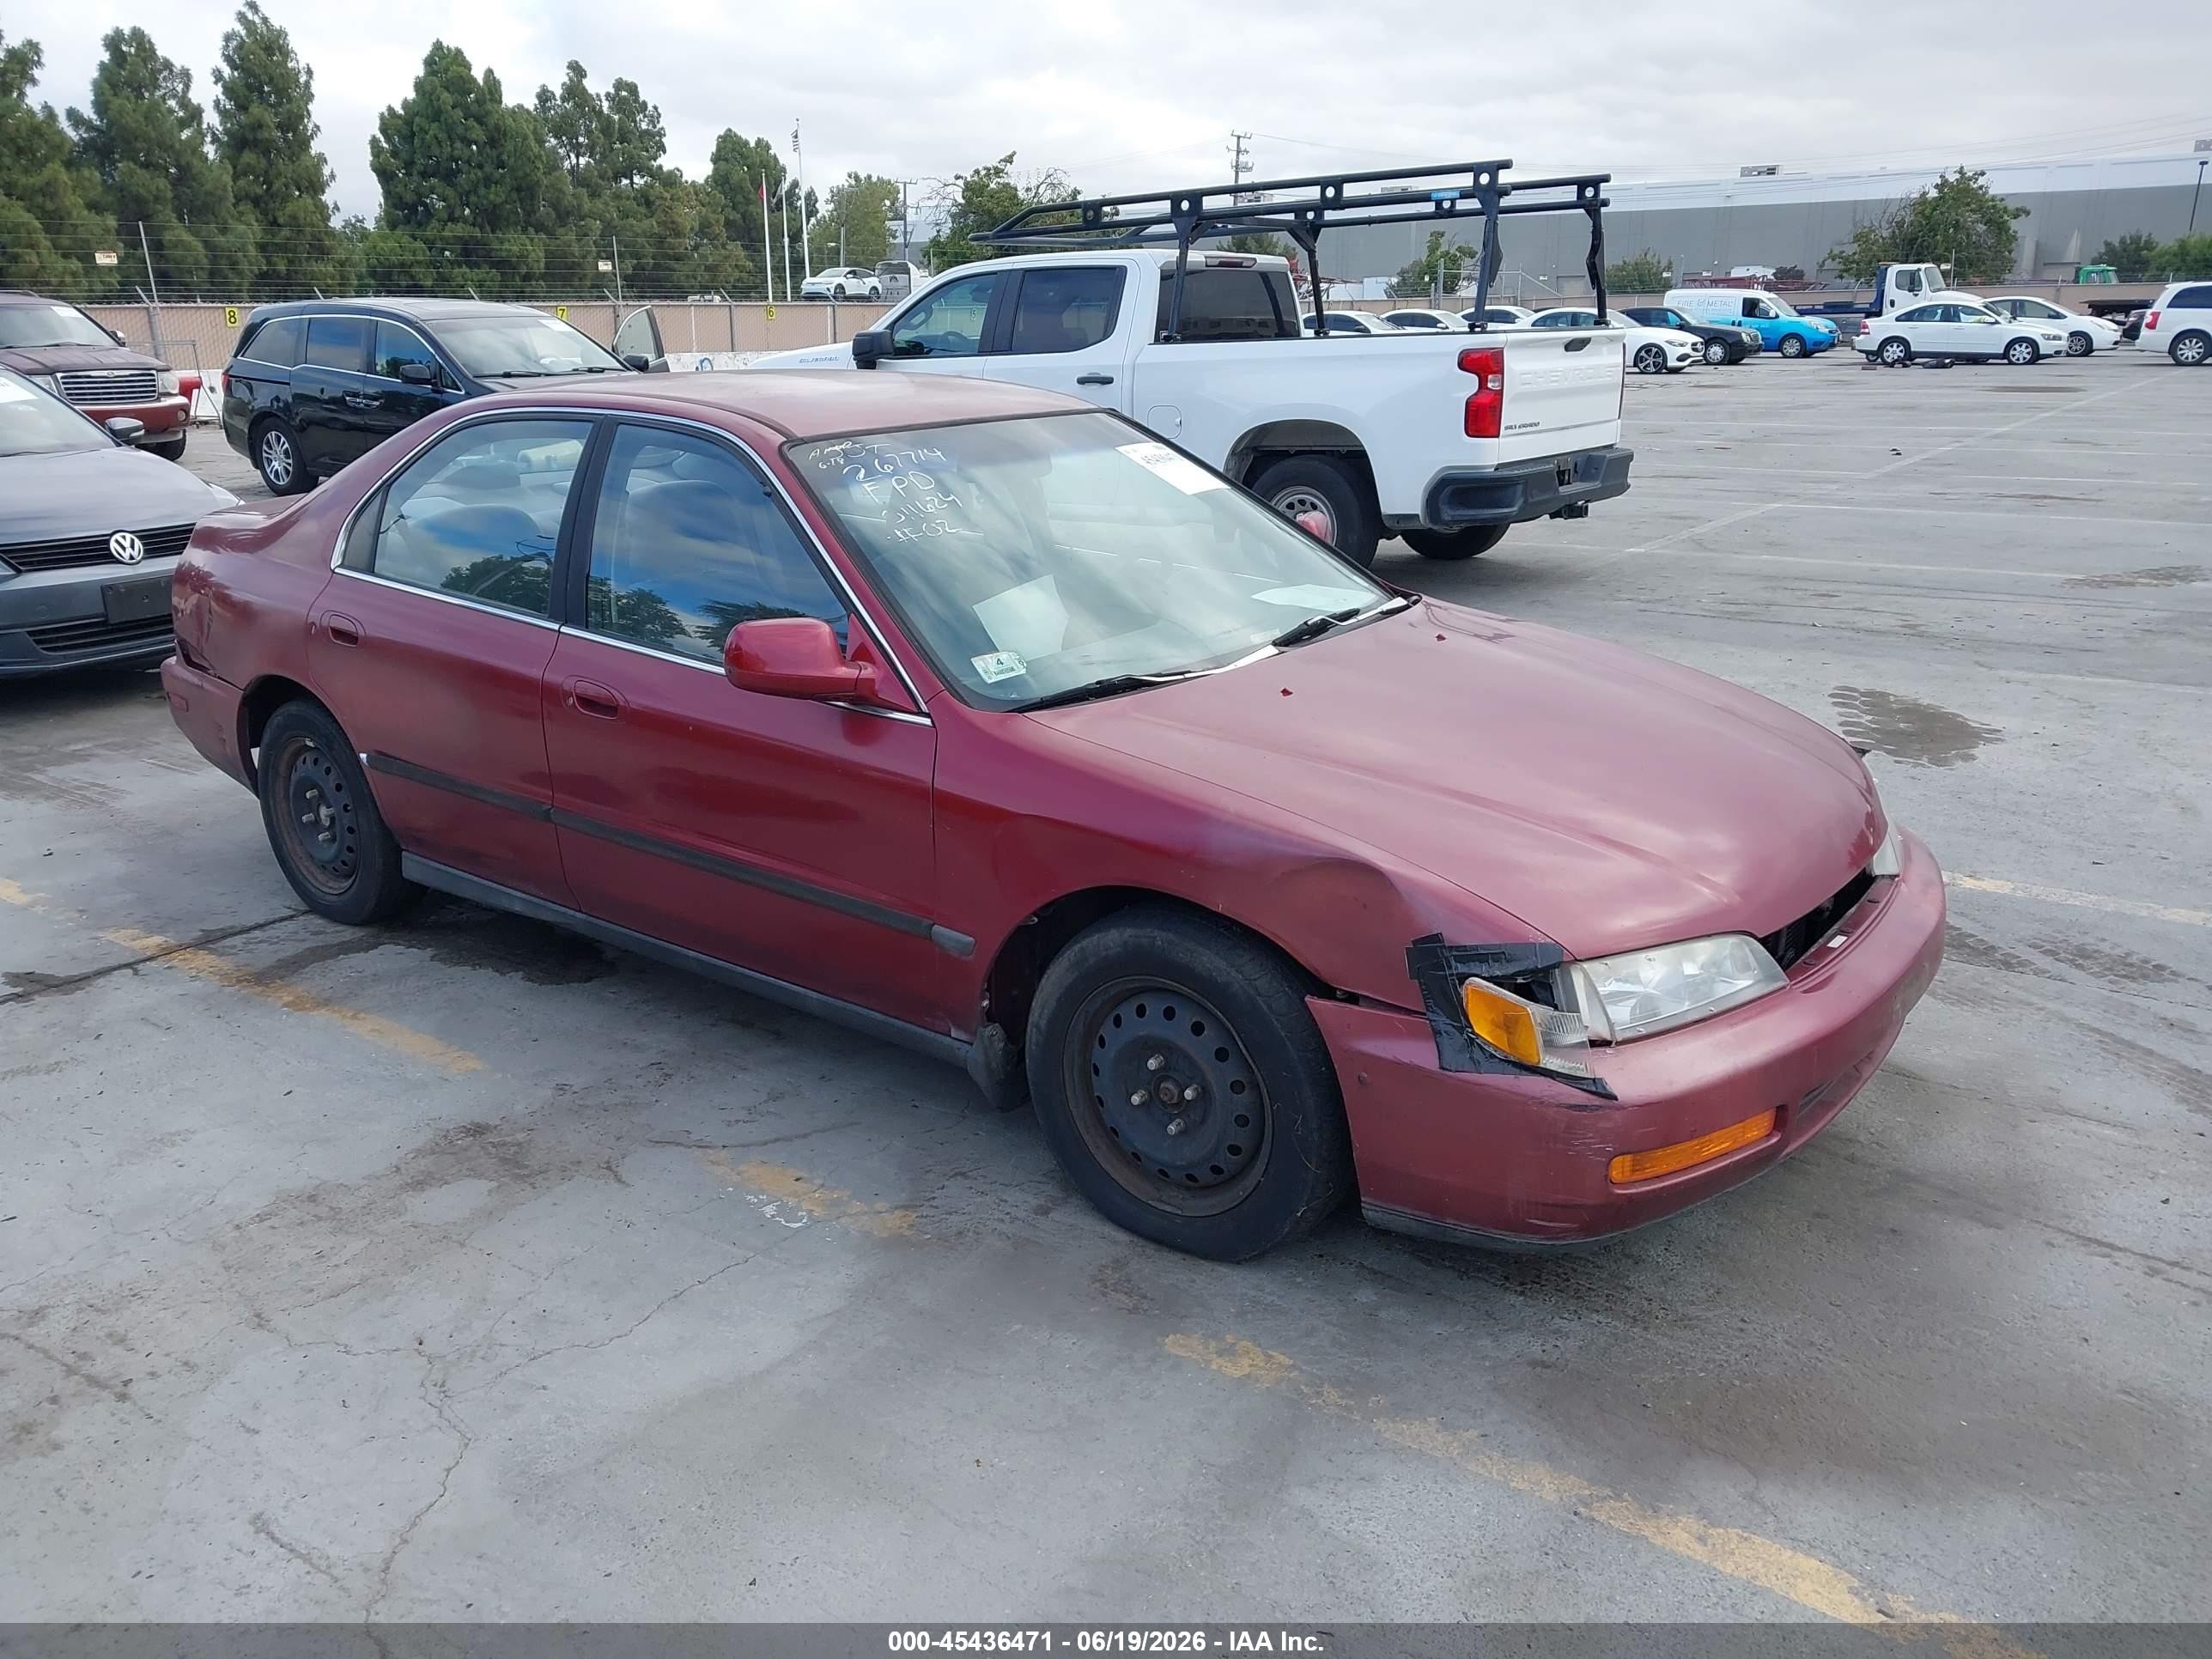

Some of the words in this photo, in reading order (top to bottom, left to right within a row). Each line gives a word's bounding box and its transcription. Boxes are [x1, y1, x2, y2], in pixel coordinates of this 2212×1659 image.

[1698, 298, 1705, 307] &
[1706, 299, 1732, 308] METAL
[228, 309, 237, 325] 8
[558, 308, 566, 319] 7
[768, 307, 775, 318] 6
[1518, 364, 1621, 389] CHEVROLET
[842, 447, 947, 481] 267714
